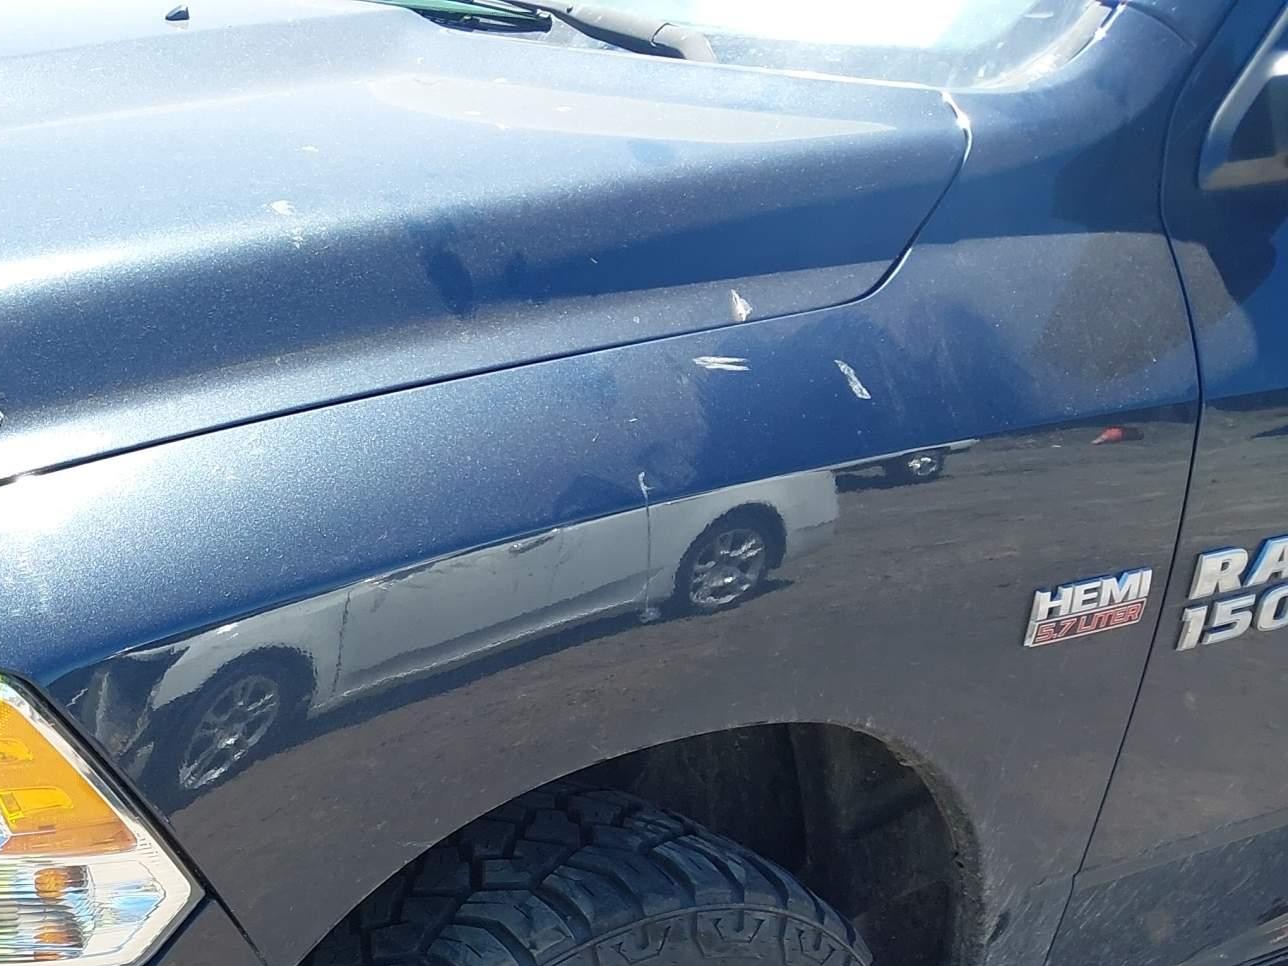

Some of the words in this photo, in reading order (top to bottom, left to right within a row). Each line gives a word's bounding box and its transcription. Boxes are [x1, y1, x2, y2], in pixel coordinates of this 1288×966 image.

[1031, 568, 1152, 621] HEMI
[1034, 618, 1078, 643] 5.7
[1077, 602, 1143, 633] LITER
